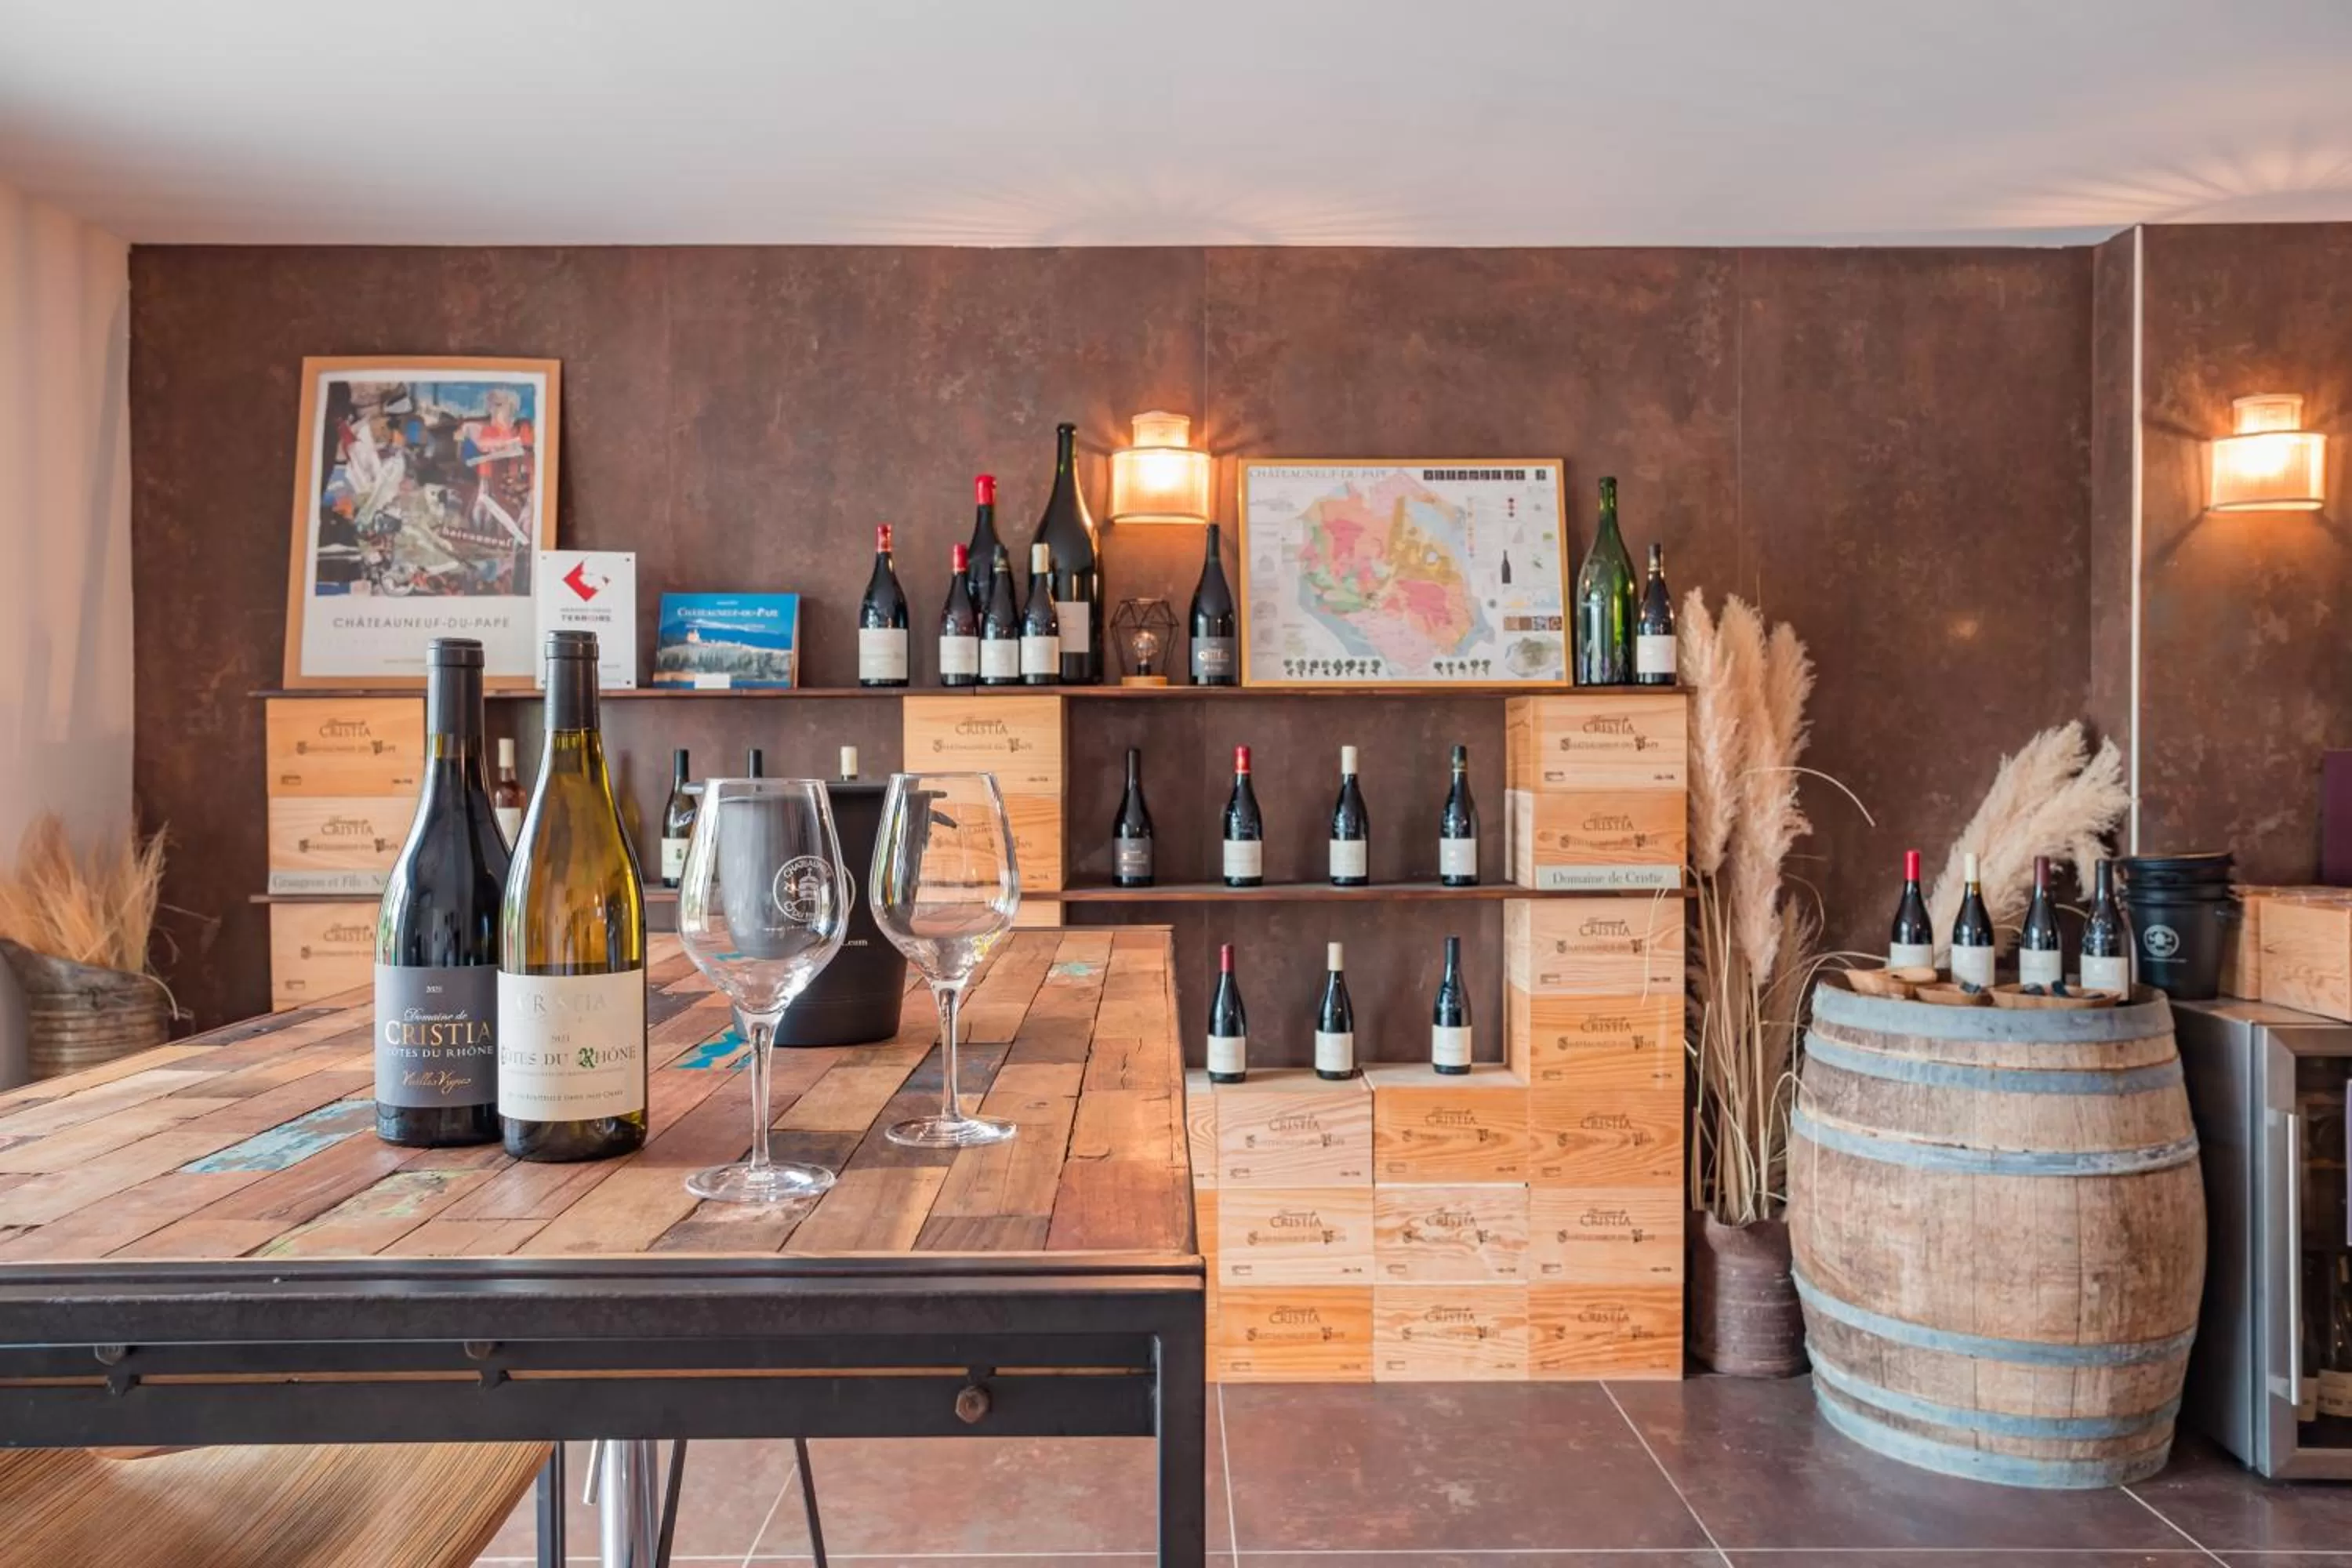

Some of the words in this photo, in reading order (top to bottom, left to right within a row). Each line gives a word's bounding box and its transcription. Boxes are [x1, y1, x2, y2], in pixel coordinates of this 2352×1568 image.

[515, 993, 608, 1014] RSTIA
[384, 1019, 492, 1047] CRISTIA
[422, 1048, 441, 1058] DU
[543, 1053, 569, 1066] DU
